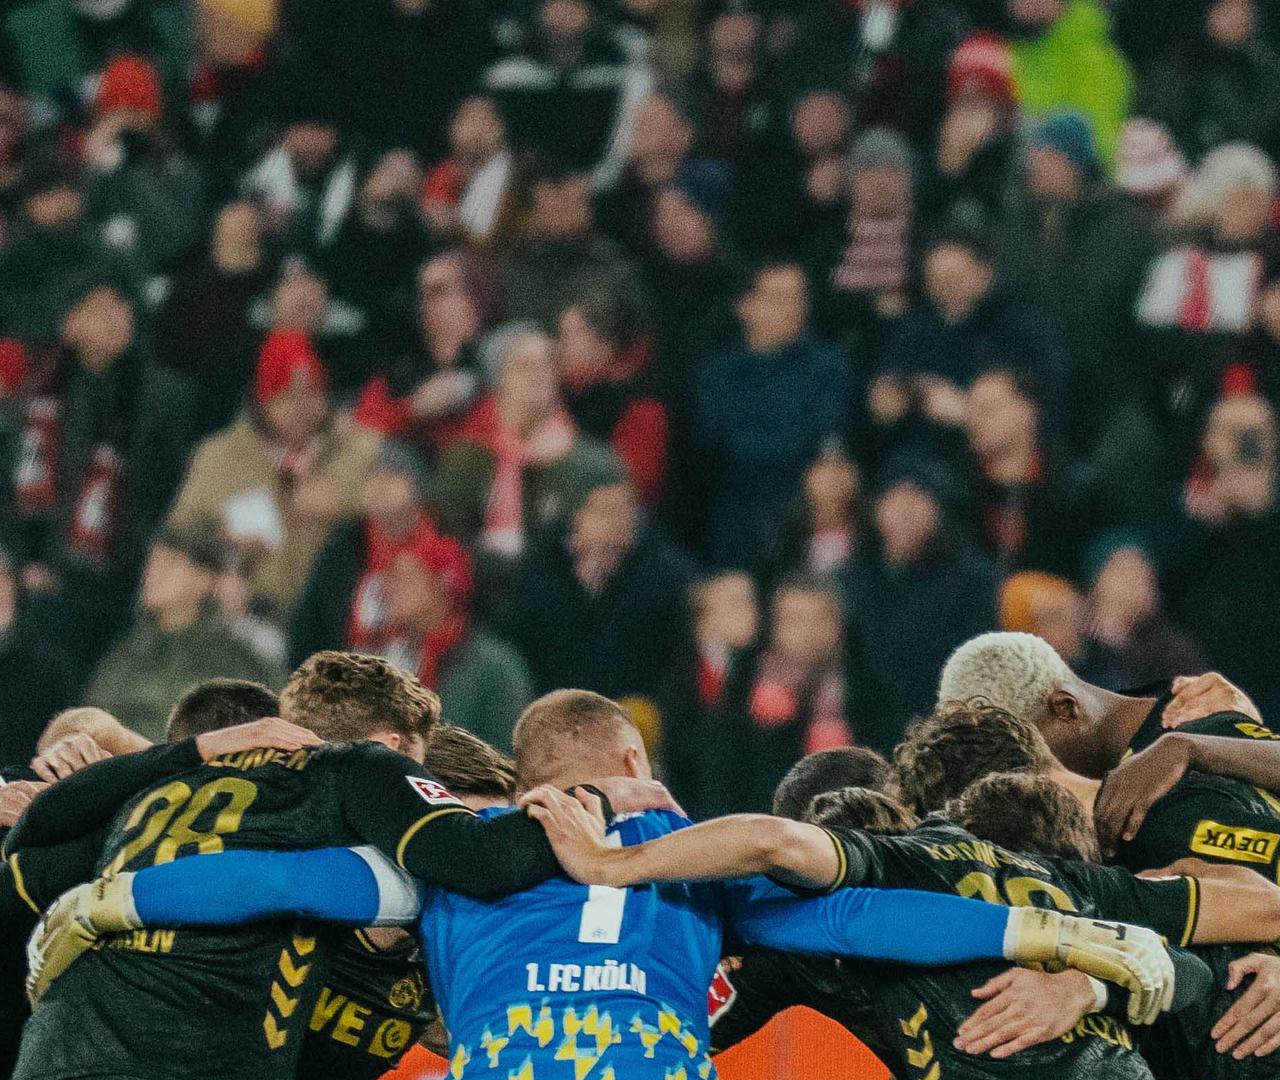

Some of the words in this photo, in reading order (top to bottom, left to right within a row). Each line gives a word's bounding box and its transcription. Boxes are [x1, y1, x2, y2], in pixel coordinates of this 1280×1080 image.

[1202, 828, 1270, 856] DEVK
[526, 963, 545, 992] 1.
[548, 963, 582, 992] FC
[583, 959, 647, 996] KÖLN
